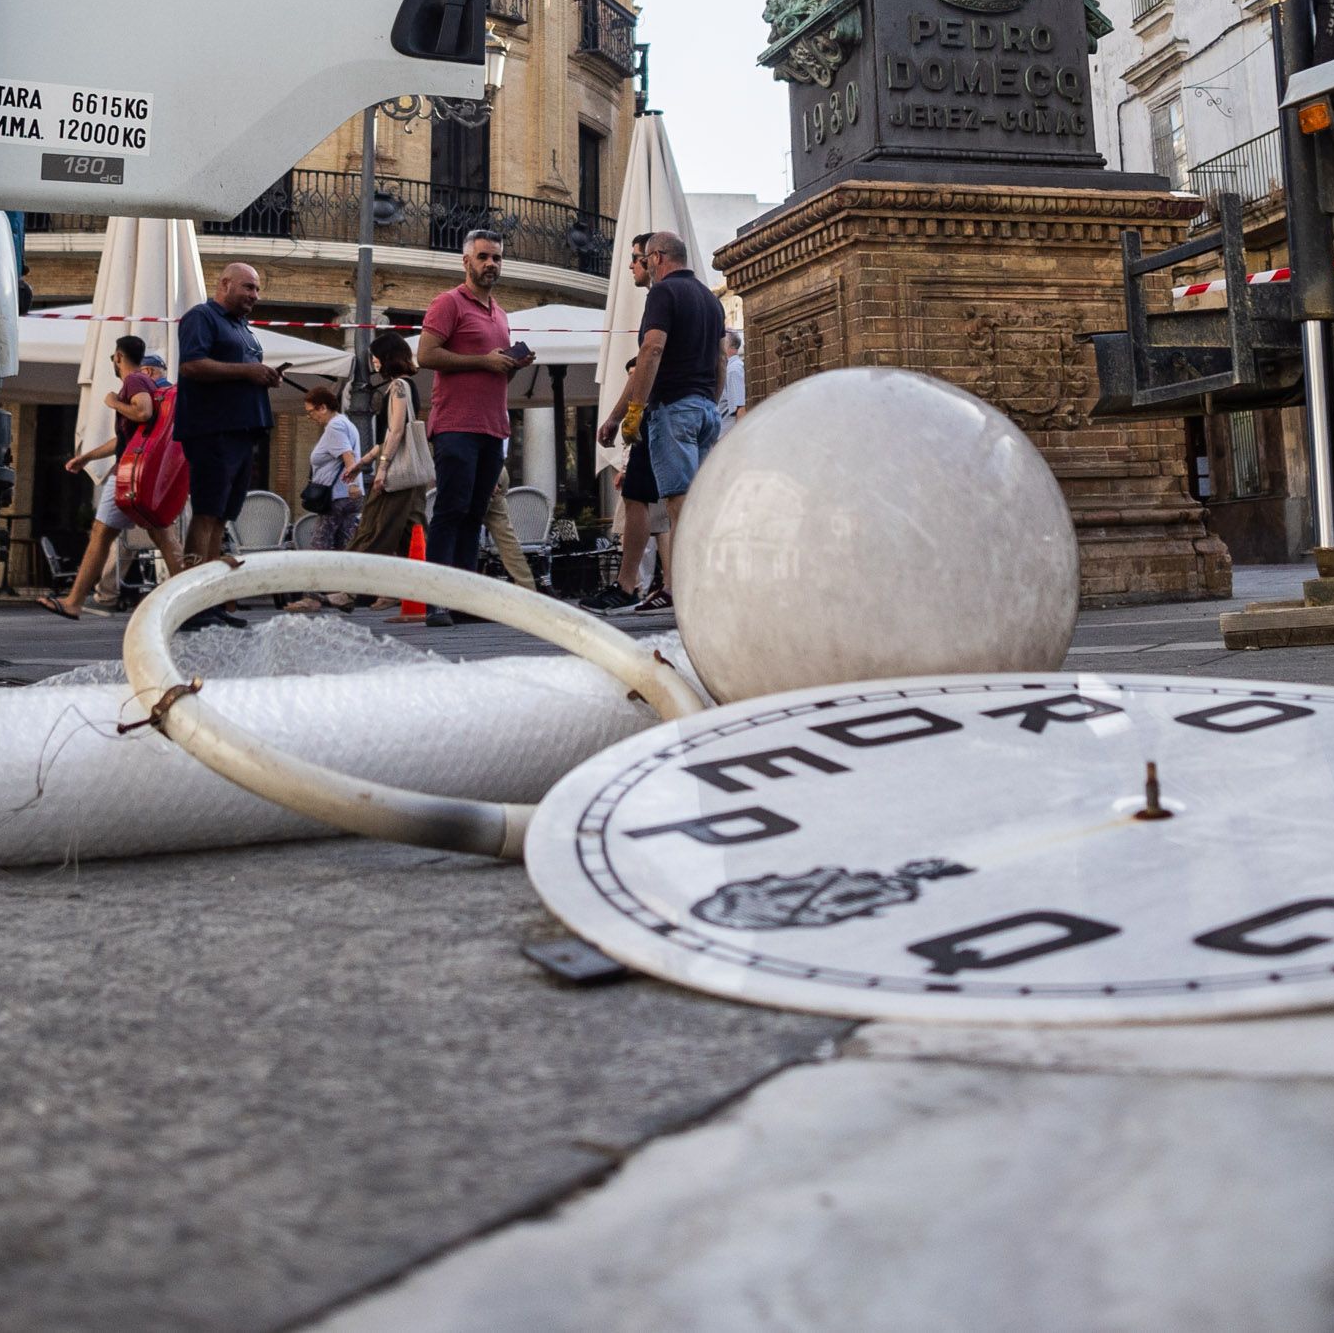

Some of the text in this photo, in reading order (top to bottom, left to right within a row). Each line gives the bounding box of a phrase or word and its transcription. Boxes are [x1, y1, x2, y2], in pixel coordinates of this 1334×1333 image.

[911, 16, 1055, 53] PEDRO
[886, 54, 1084, 105] DOMECQ
[803, 81, 859, 153] 1930
[64, 156, 106, 175] 180
